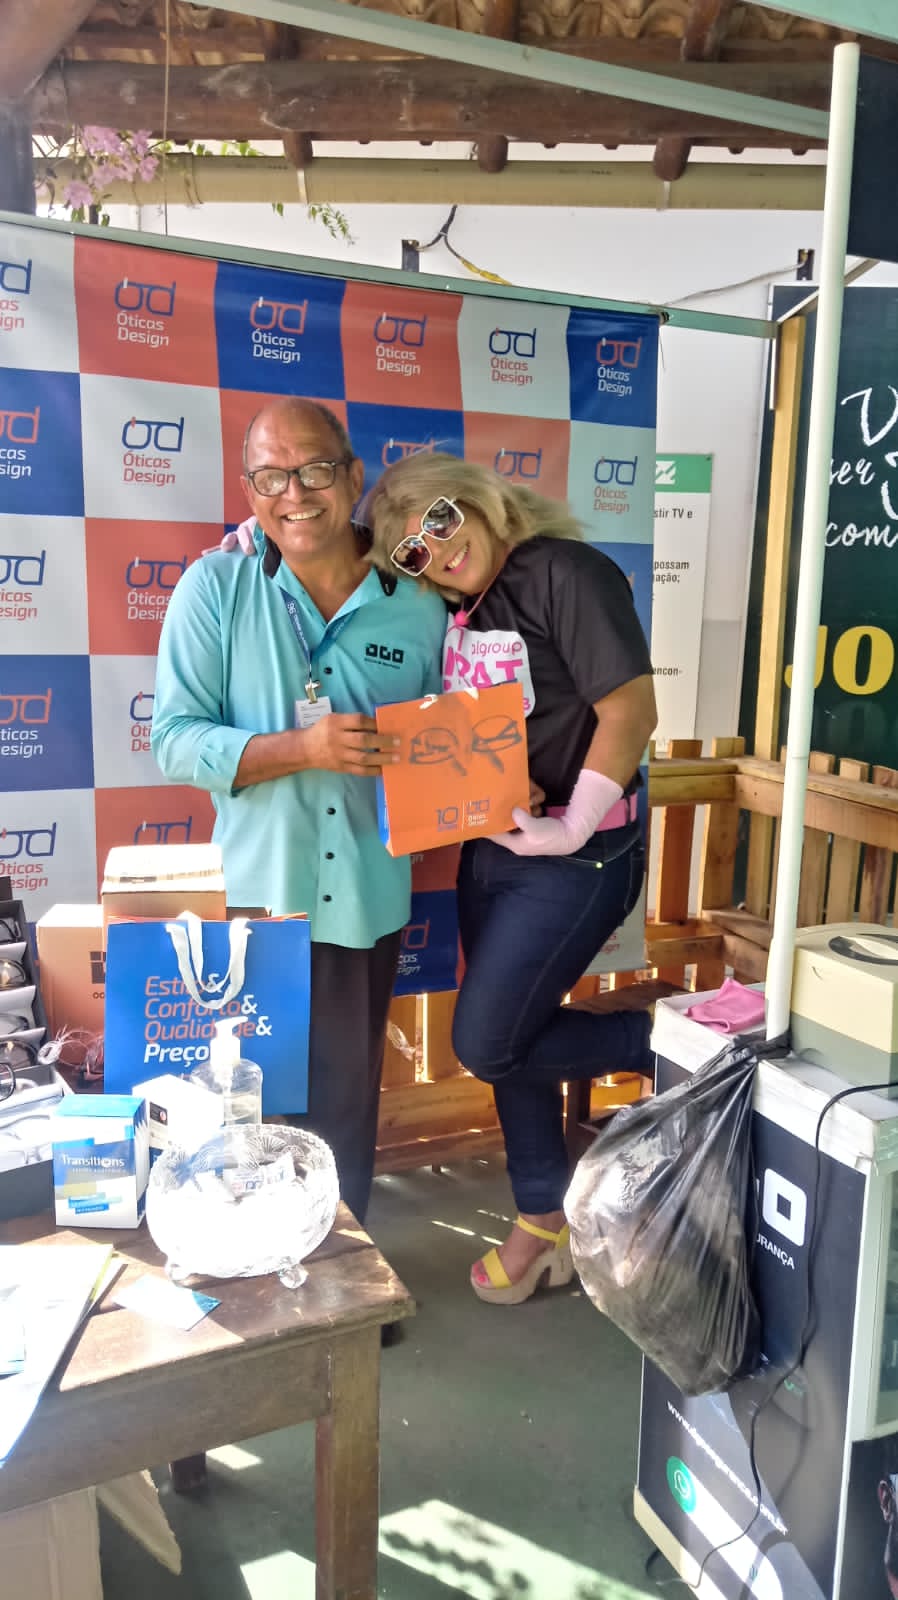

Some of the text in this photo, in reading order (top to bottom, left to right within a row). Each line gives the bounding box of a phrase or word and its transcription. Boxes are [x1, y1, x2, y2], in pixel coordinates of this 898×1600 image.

[116, 310, 165, 331] Óticas
[117, 327, 170, 348] Design
[251, 328, 296, 347] Óticas
[253, 345, 301, 363] Design
[375, 343, 417, 361] Óticas
[376, 358, 421, 376] Design
[490, 356, 529, 372] Óticas
[597, 364, 630, 382] Óticas
[491, 370, 533, 387] Design
[597, 379, 632, 397] Design
[122, 450, 171, 470] Óticas
[123, 468, 176, 487] Design
[593, 485, 628, 500] Óticas
[593, 499, 630, 514] Design
[672, 508, 685, 519] TV
[687, 511, 693, 519] e
[654, 561, 690, 573] possam
[653, 573, 681, 585] ação;
[144, 1015, 273, 1045] Qualide&
[144, 1043, 210, 1068] Preço
[62, 1153, 125, 1168] Transitions
